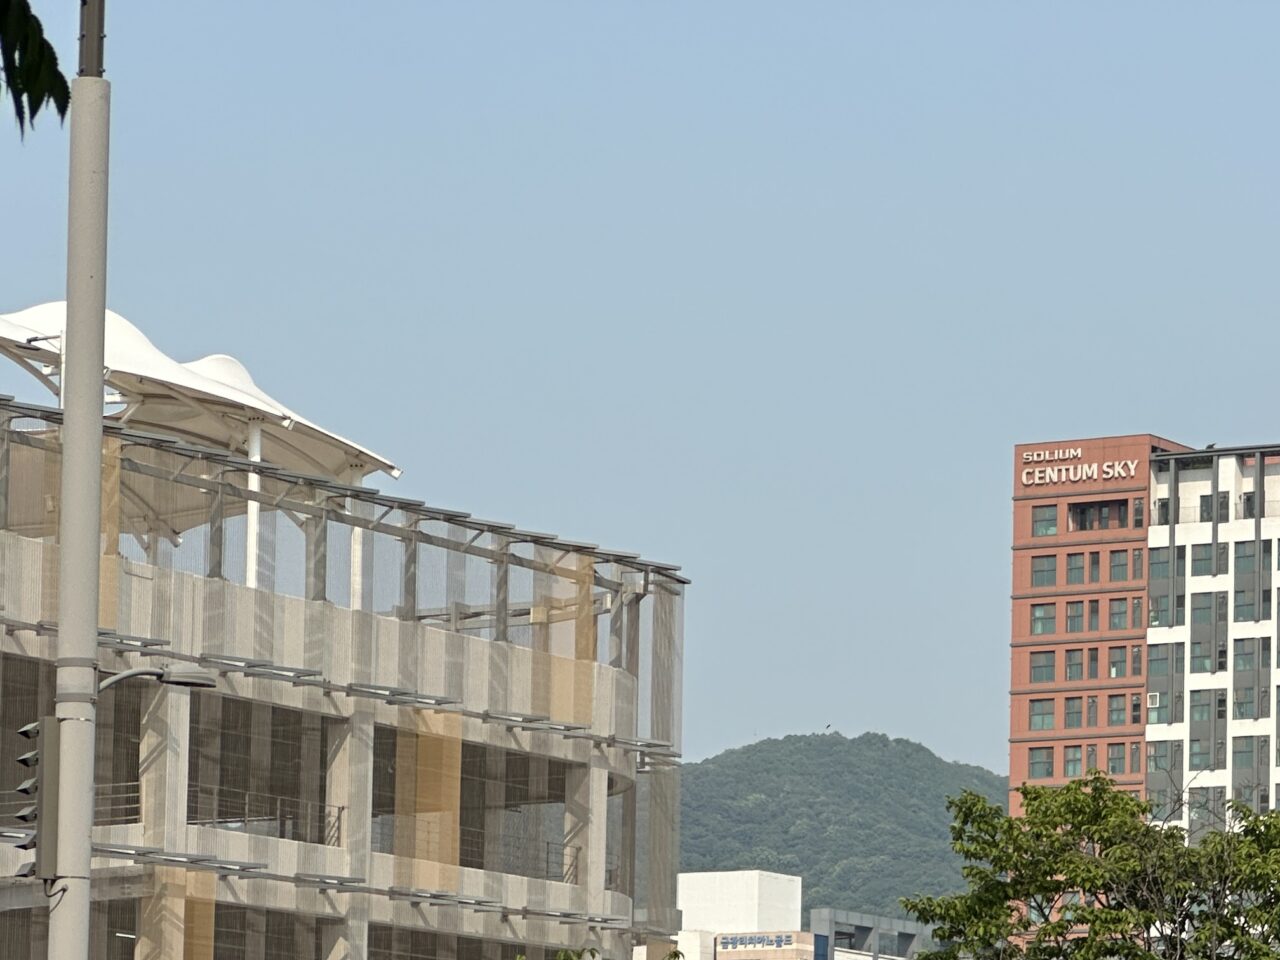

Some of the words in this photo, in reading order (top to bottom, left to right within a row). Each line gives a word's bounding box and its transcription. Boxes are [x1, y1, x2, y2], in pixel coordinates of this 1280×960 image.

[1022, 448, 1082, 463] SOLIUM
[1021, 463, 1098, 486] CENTUM
[1102, 460, 1139, 479] SKY
